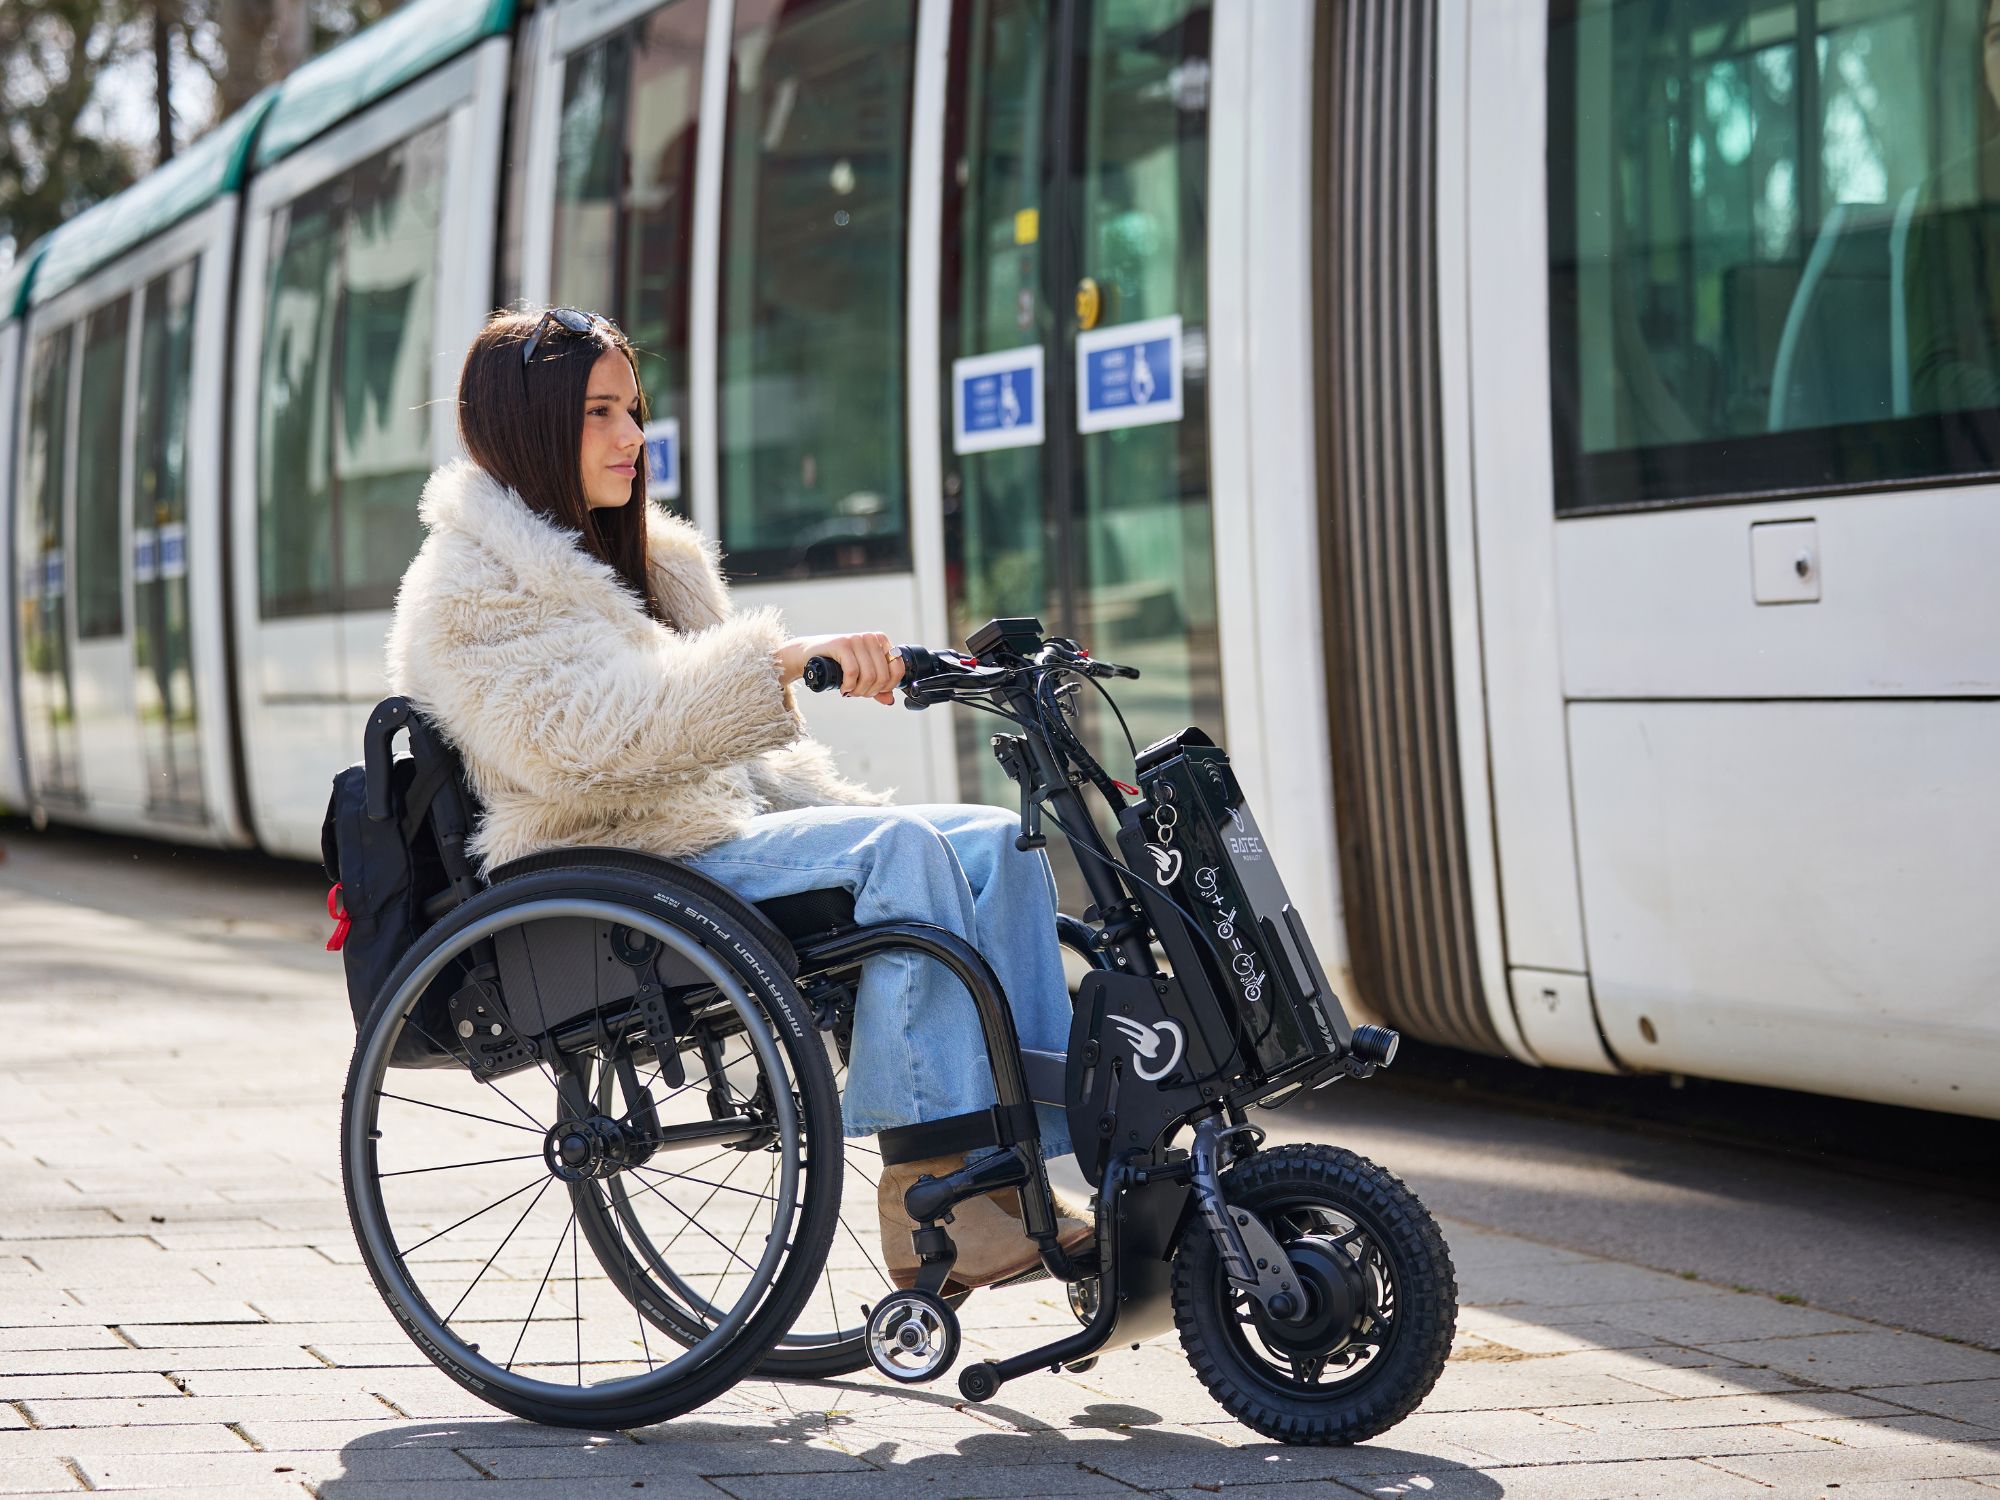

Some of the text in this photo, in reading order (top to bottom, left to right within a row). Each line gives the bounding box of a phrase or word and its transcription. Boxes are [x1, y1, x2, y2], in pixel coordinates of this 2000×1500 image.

[1229, 837, 1263, 854] BATEC
[683, 906, 804, 1038] MARATHON PLUS
[1190, 1154, 1254, 1281] BATEC
[387, 1291, 486, 1390] SCHWALBE
